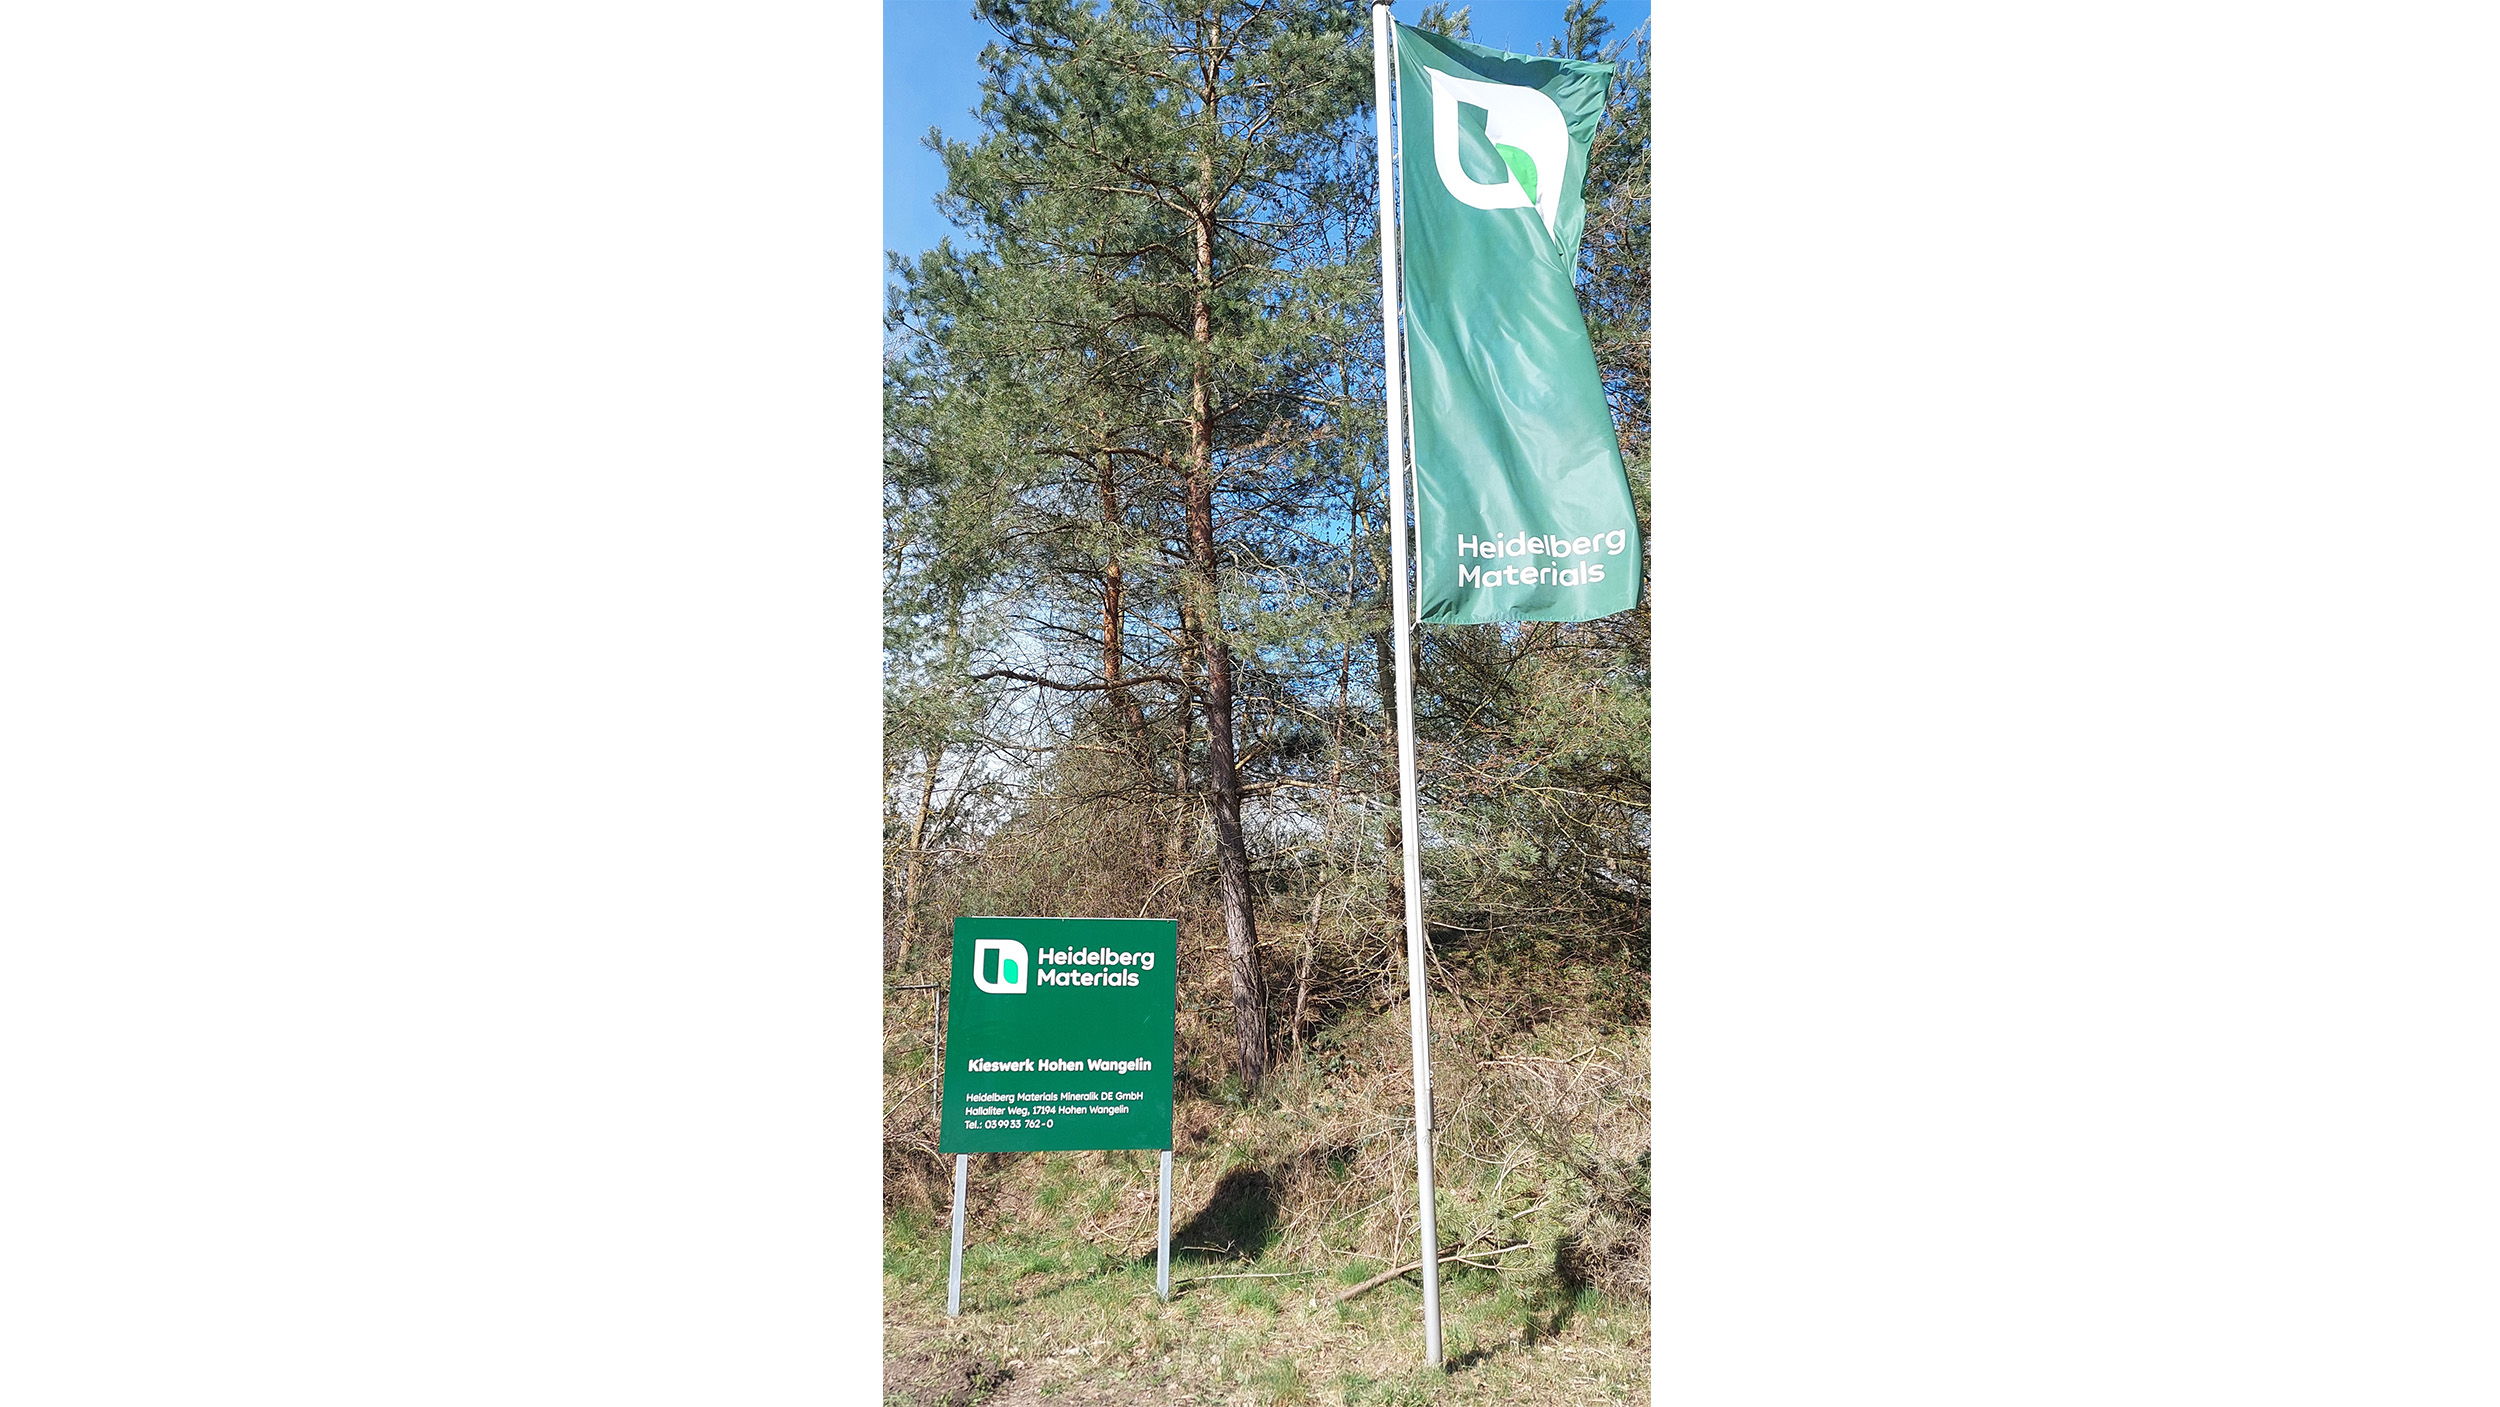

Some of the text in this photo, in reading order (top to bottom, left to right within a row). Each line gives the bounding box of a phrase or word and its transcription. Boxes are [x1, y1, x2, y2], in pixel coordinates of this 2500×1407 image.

[1457, 528, 1626, 560] Heidelberg
[1458, 560, 1606, 589] Materials
[1038, 946, 1155, 970] Heidelberg
[1037, 967, 1140, 987] Materials
[967, 1056, 1152, 1075] Kieswerk Hohen Wangelin
[965, 1091, 1144, 1104] Heidelberg Materials Mineralik DE GmbH
[965, 1104, 1130, 1118] Hallaliter Weg, 17194 Hohen Wangelin
[964, 1119, 983, 1130] Tel.:
